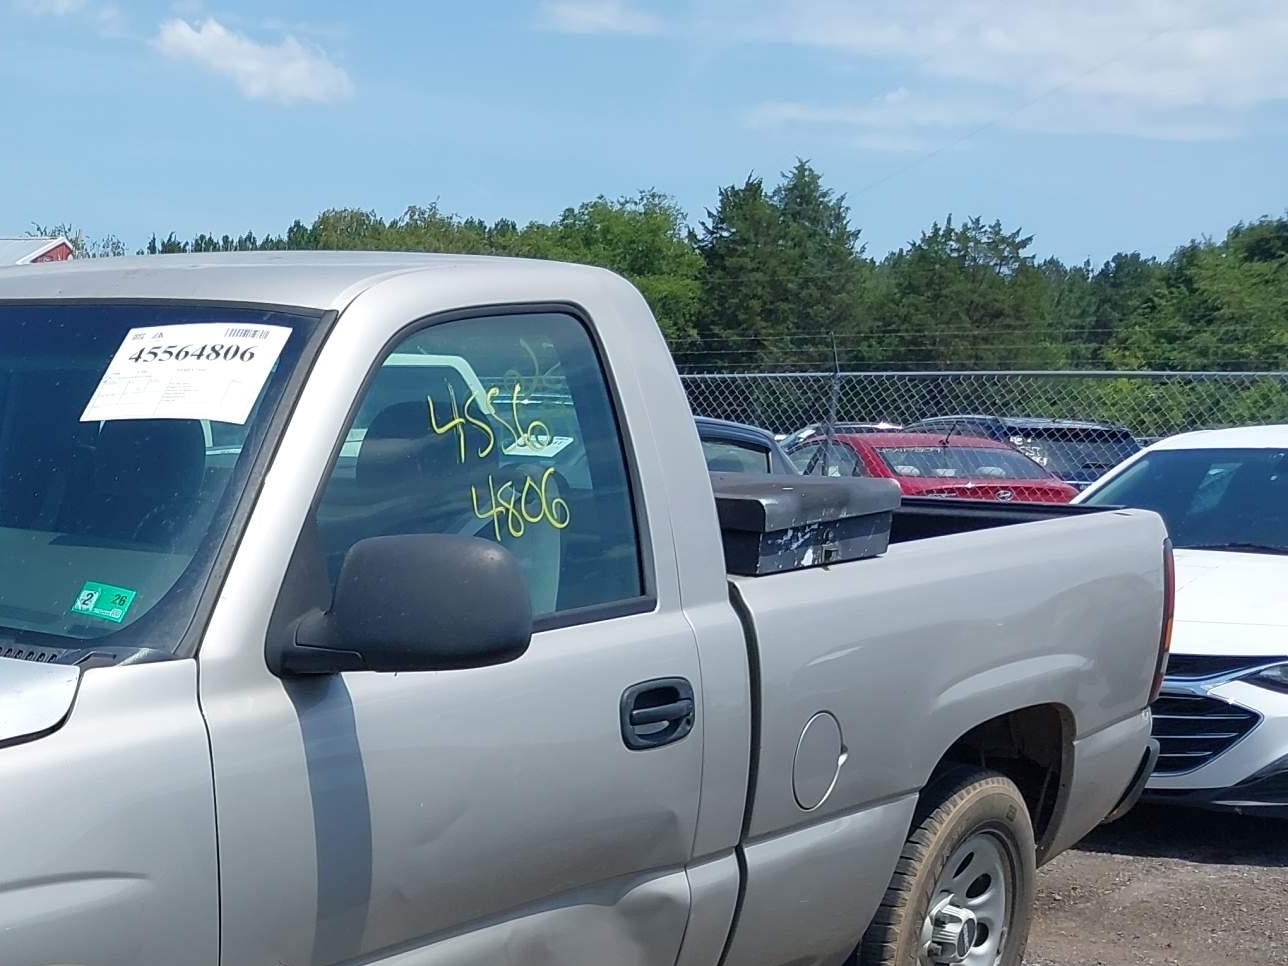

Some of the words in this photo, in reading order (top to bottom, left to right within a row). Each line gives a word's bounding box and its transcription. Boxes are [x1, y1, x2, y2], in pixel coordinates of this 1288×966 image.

[128, 343, 262, 364] 45564806
[427, 383, 552, 463] 4556
[471, 467, 570, 541] 4806
[82, 592, 94, 606] 2
[111, 593, 128, 607] 26
